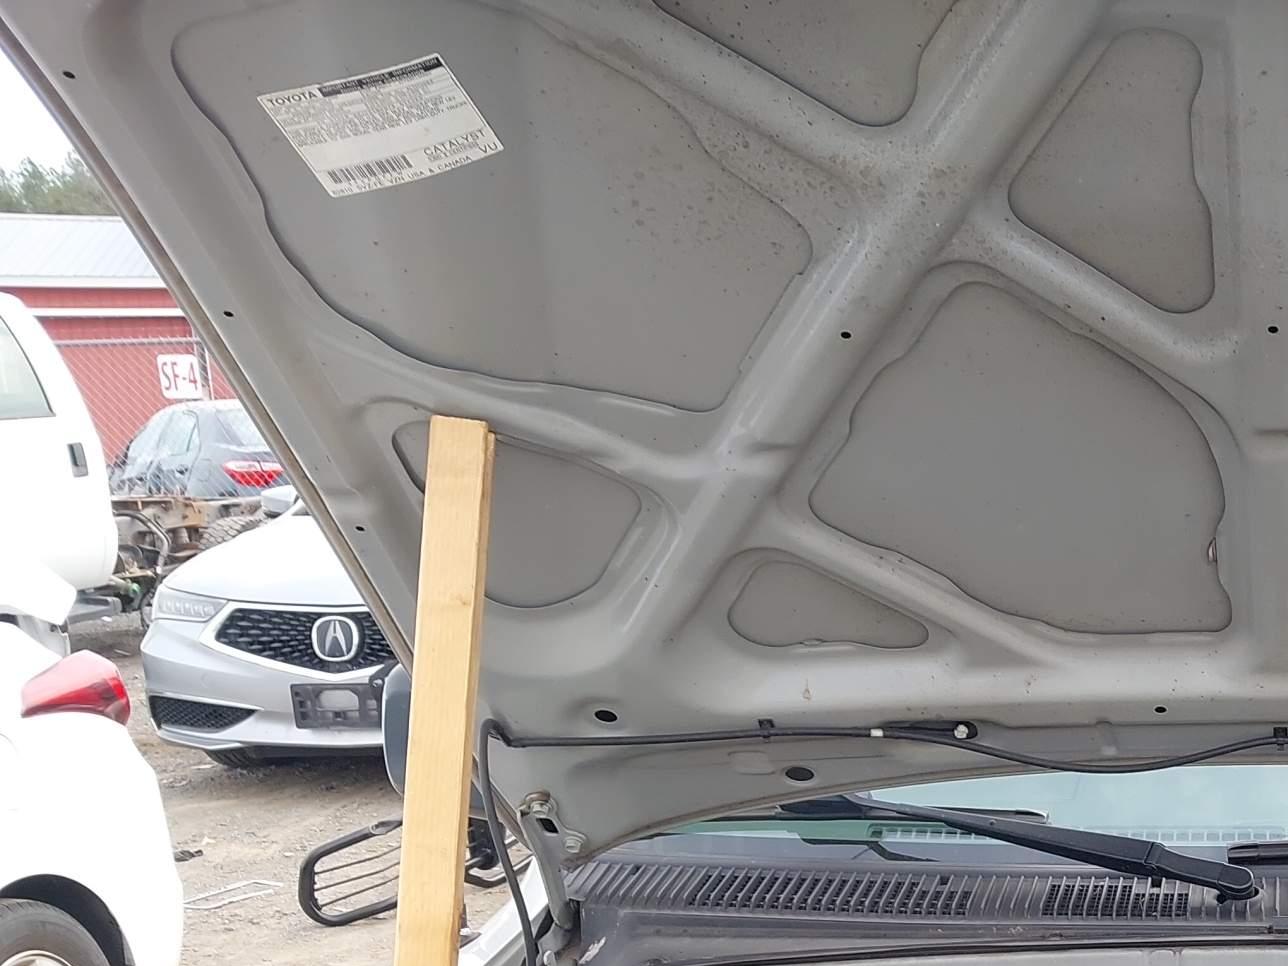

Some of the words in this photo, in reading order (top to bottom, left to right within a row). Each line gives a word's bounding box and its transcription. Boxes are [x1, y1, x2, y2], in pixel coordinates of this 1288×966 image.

[267, 90, 318, 107] TOYOTA
[423, 129, 486, 158] CATALYST
[478, 142, 499, 154] VU
[437, 155, 474, 171] CANADA
[161, 361, 198, 391] SF-4
